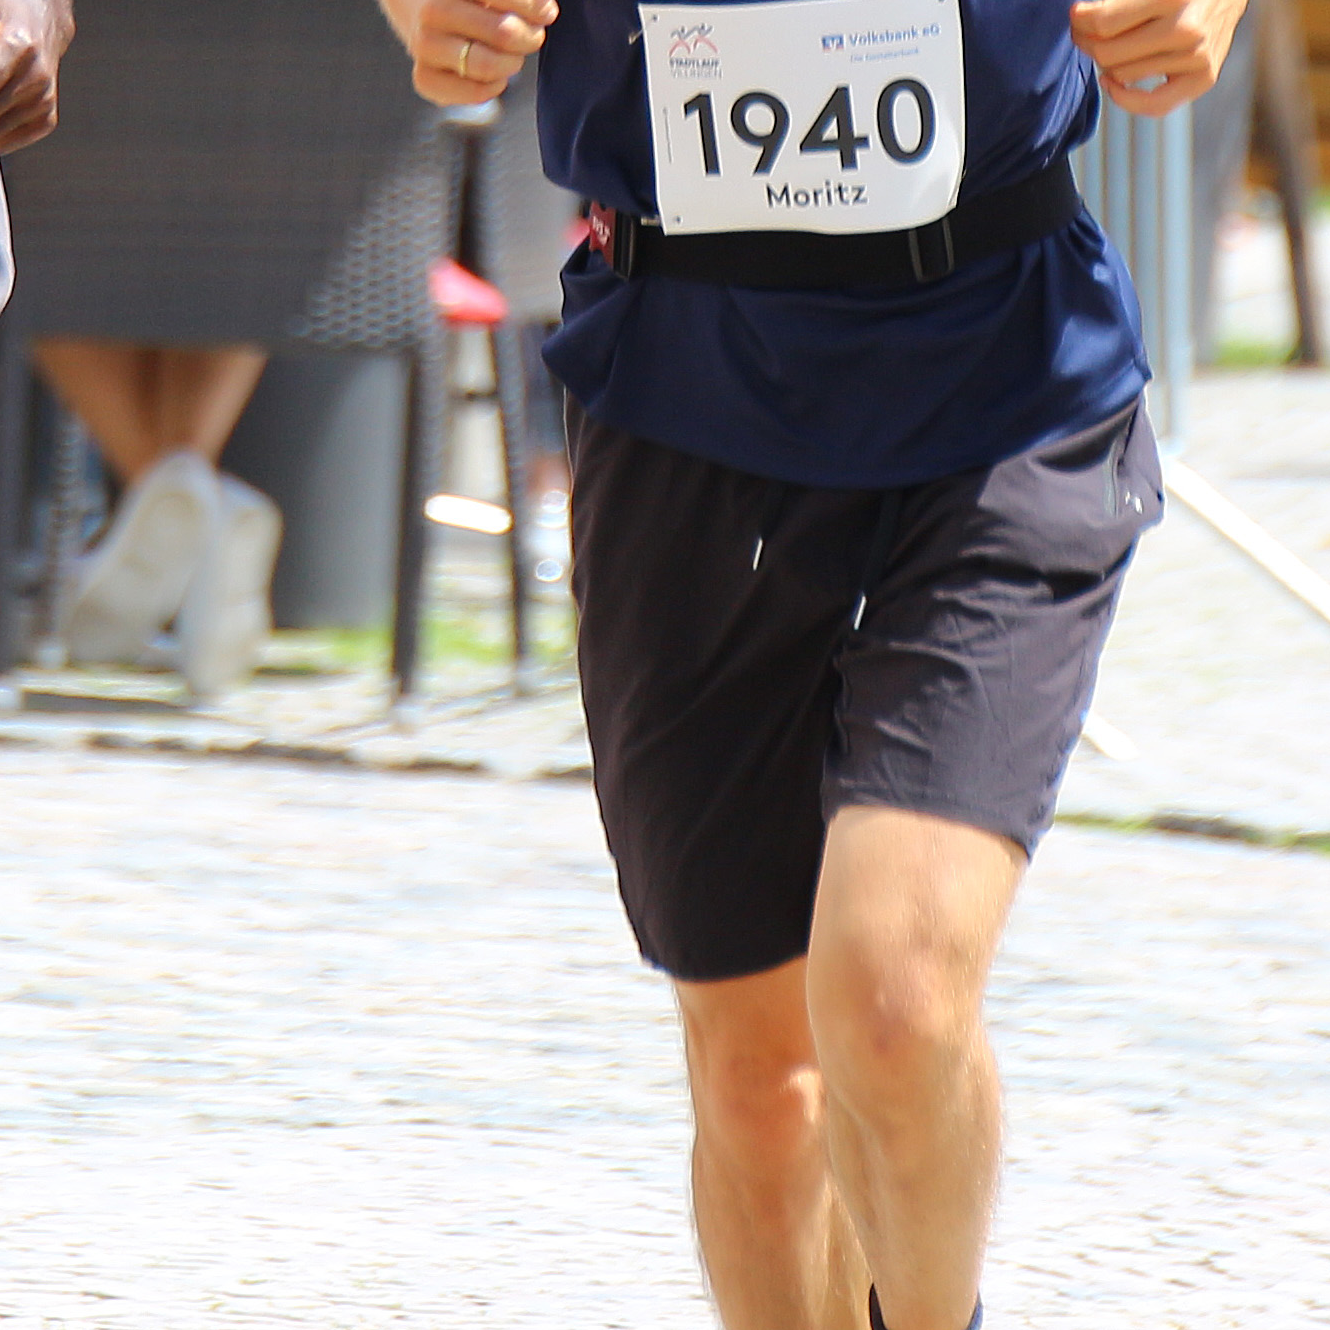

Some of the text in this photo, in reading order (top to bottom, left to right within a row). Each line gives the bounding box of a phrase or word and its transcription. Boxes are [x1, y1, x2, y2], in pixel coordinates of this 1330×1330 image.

[849, 25, 919, 47] Volksbank
[683, 78, 937, 178] 1940
[765, 179, 869, 209] Moritz
